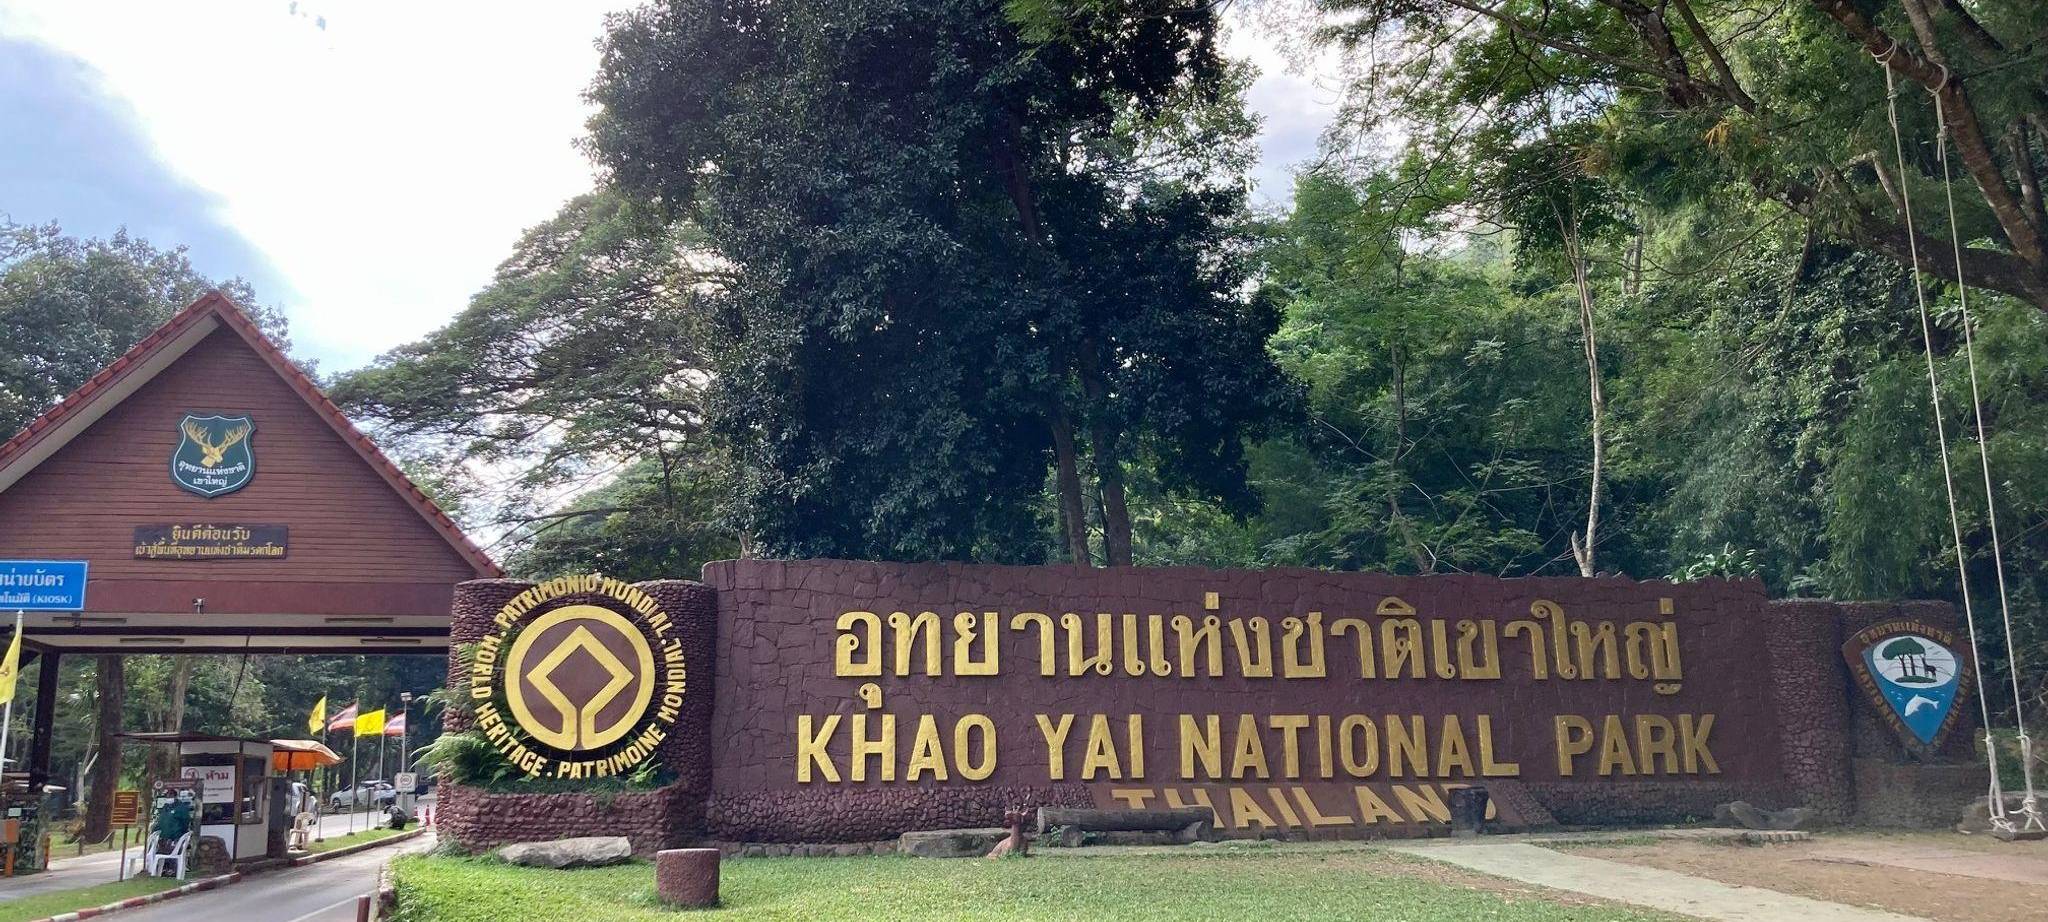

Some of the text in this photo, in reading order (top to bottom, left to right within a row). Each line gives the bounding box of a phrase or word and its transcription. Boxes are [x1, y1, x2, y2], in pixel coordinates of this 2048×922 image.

[178, 460, 246, 475] อุทยานแห่งชาติ
[193, 475, 228, 487] เขาใหญ่
[172, 524, 250, 541] ยินดีต้อนรับ
[32, 594, 72, 604] (KIOSK)
[494, 575, 673, 638] PATRIMONIO MUNDIAL
[835, 591, 1683, 709] อุทยานแห่งชาติเขาใหญ่
[471, 634, 548, 777] WORLD HERITAGE
[557, 638, 686, 779] PATRIMOINE MONDIAL
[797, 713, 1721, 783] KHAO YAI NATIONAL PARK
